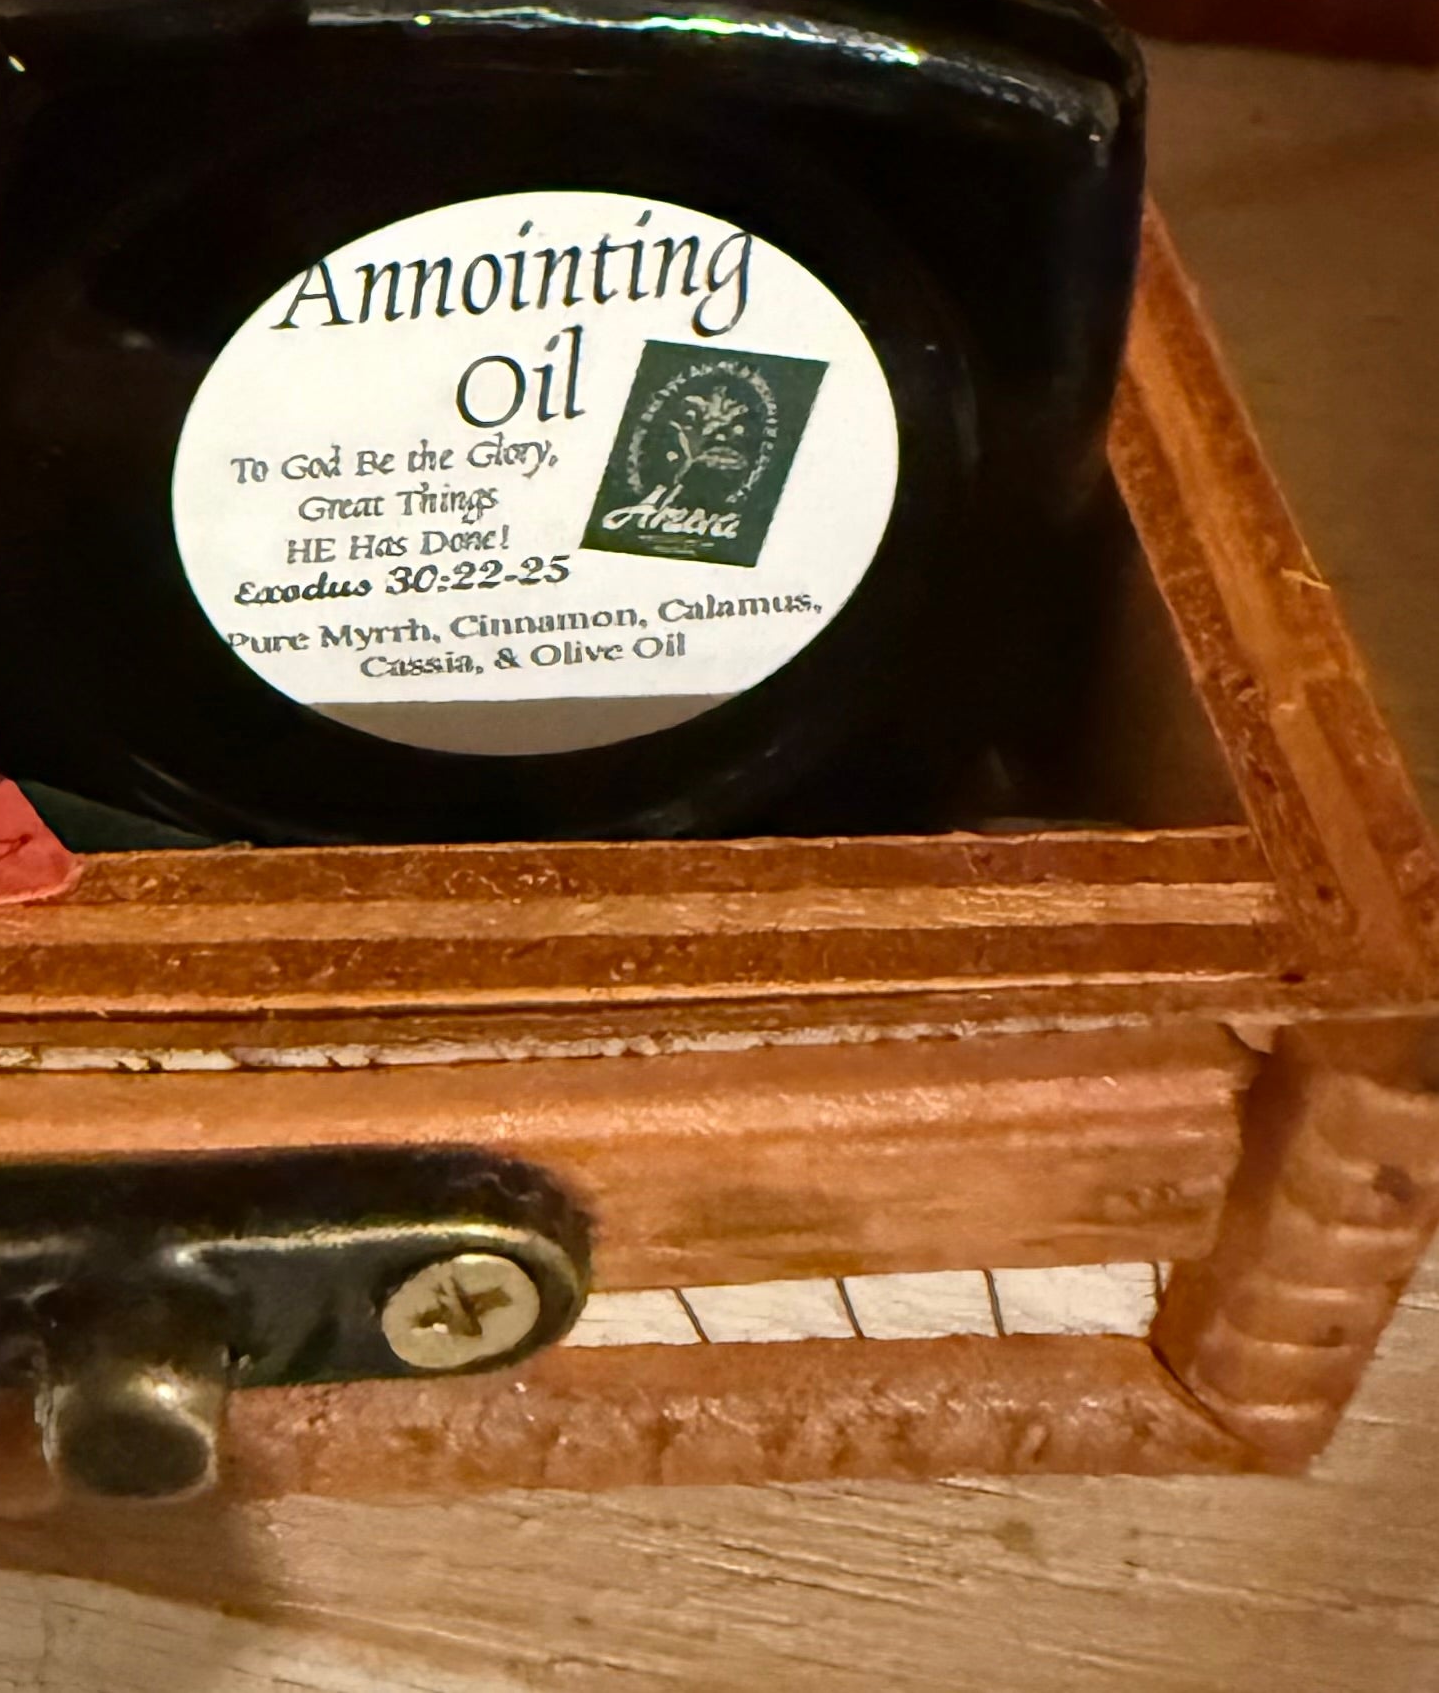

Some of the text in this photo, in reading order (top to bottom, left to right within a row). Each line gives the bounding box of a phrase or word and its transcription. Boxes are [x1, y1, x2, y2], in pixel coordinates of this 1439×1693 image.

[269, 210, 755, 337] Annointing
[456, 326, 587, 428] Oil
[230, 432, 559, 484] To God Be the Glory,
[298, 482, 499, 524] Great Things
[287, 524, 510, 564] HE Has Done!
[234, 554, 572, 606] Exodus 30:22-25
[226, 590, 824, 657] Pure Myrrh, Cinnamon, Calamus,
[360, 632, 687, 678] Cassia, & Olive Oil
